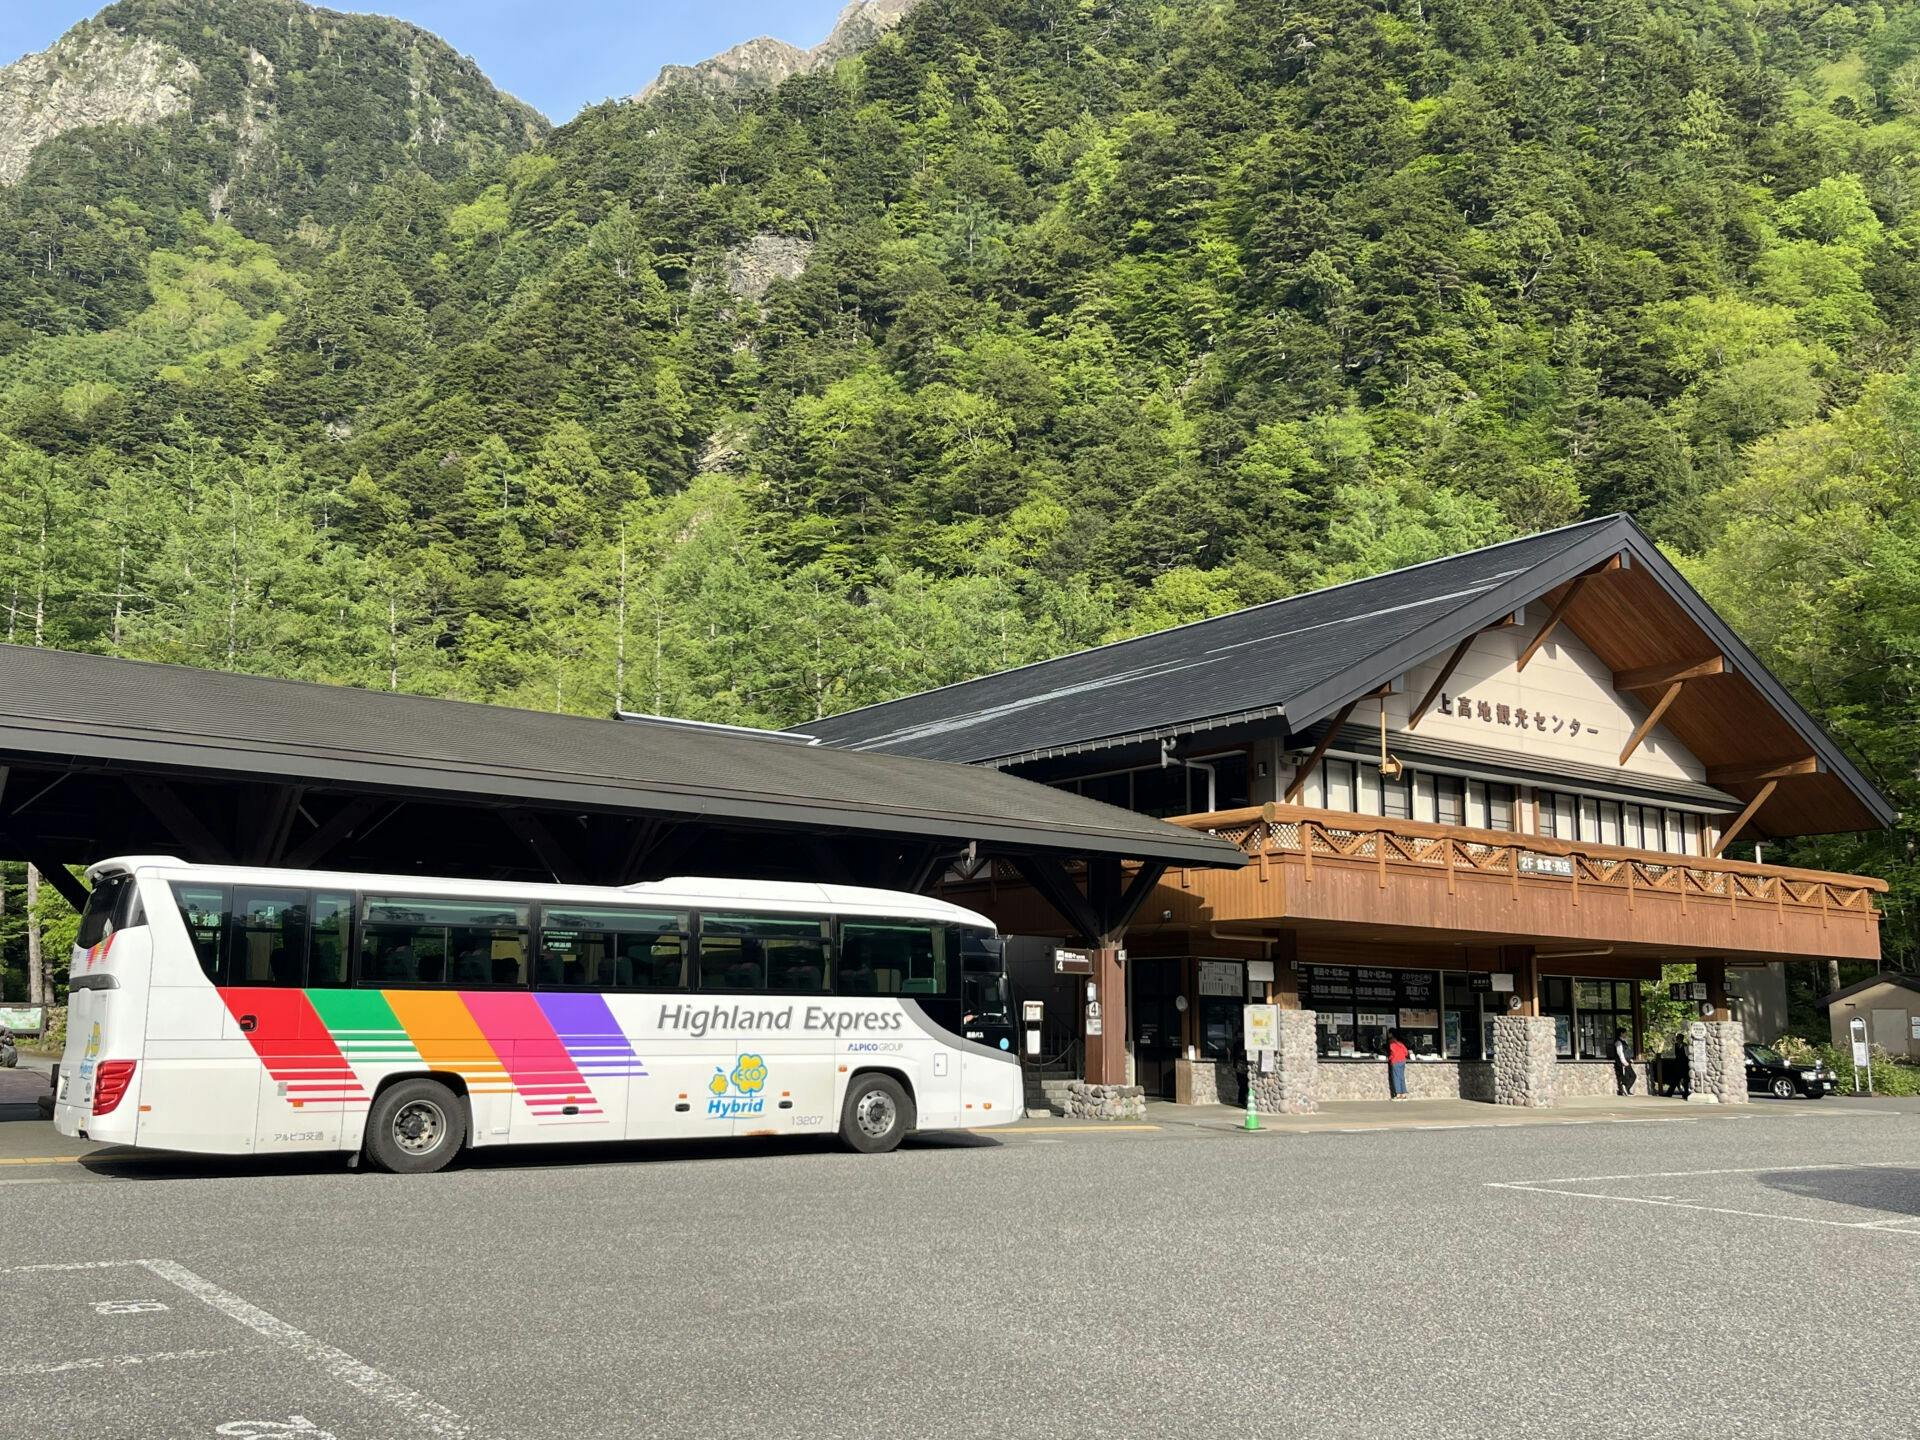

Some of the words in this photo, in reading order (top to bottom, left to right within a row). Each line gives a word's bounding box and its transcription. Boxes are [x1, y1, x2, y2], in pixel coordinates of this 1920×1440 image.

[1437, 692, 1599, 737] 上高地観光センター
[1521, 857, 1534, 869] 2F
[1057, 960, 1064, 972] 4
[1090, 1003, 1097, 1015] 4
[657, 1004, 793, 1037] Highland
[803, 1006, 903, 1037] Express
[848, 1042, 878, 1051] ALPICO
[879, 1042, 904, 1051] GROUP
[737, 1068, 762, 1081] ECO
[708, 1099, 764, 1118] Hybrid
[791, 1115, 824, 1126] 13207
